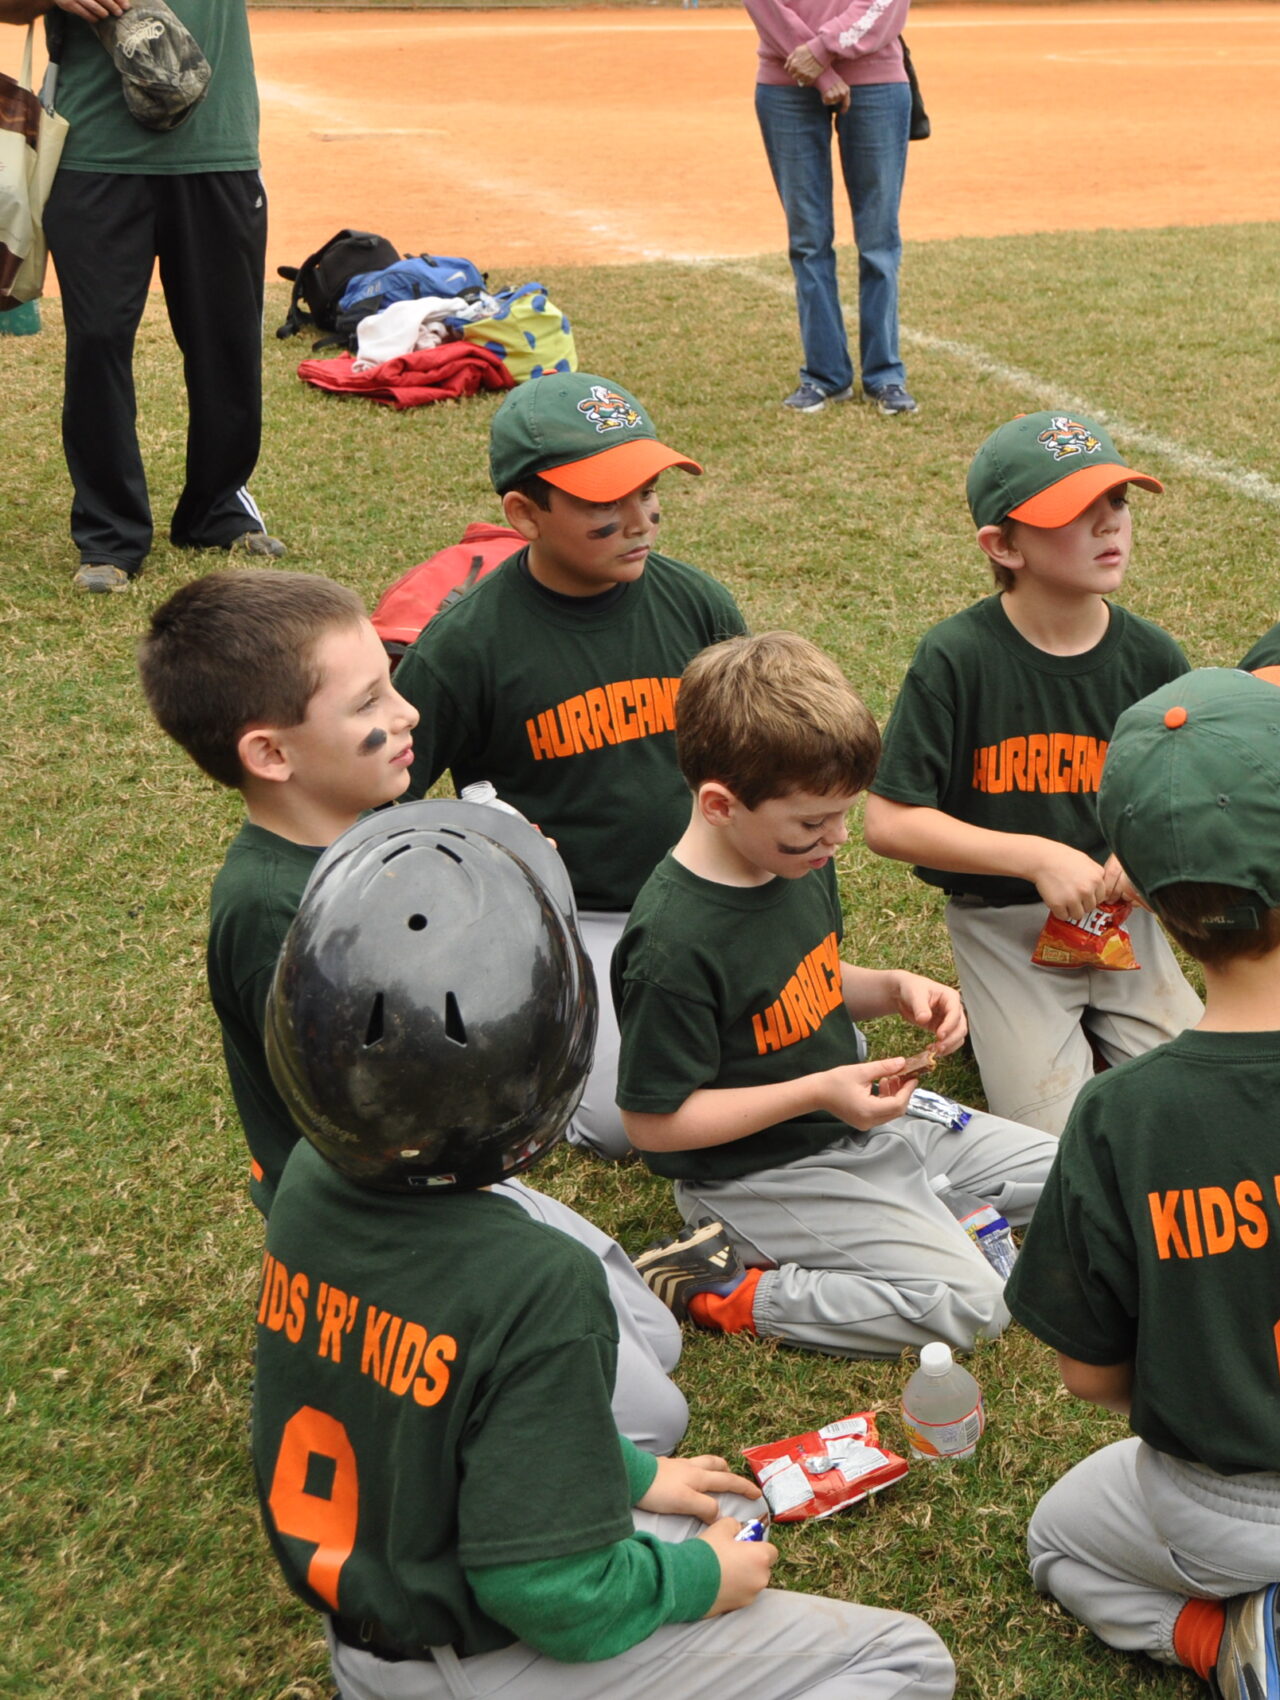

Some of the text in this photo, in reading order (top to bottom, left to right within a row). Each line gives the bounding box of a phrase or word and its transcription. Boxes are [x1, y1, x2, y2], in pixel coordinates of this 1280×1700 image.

[525, 677, 683, 761] HURRICAN
[752, 931, 844, 1055] HURRIC
[1147, 1180, 1269, 1260] KIDS
[257, 1250, 309, 1344] IDS
[360, 1305, 458, 1408] KIDS
[268, 1405, 359, 1612] 9
